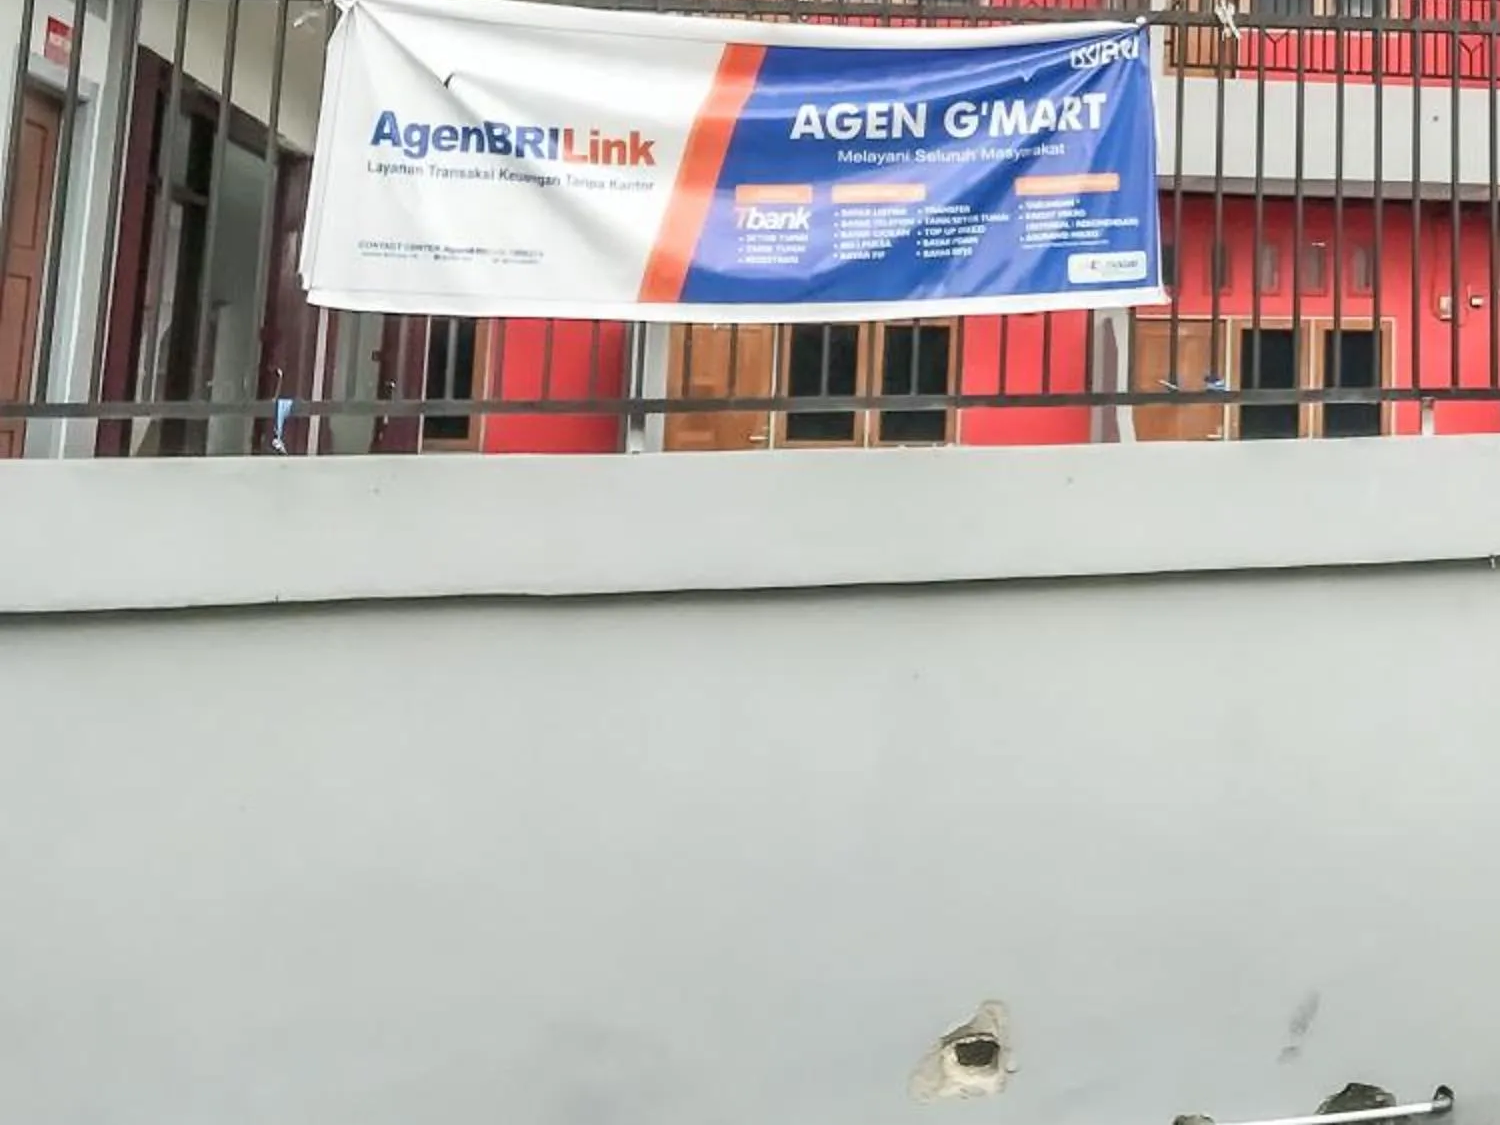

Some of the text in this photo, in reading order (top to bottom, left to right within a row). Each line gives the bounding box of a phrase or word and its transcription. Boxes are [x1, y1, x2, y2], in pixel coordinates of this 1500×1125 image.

[790, 92, 1107, 140] AGEN G'MART
[370, 110, 656, 167] AgenBRILink
[837, 149, 912, 166] Melayani
[914, 147, 977, 164] Seluruh
[367, 160, 424, 176] Layanan
[428, 164, 495, 181] Transaksi
[609, 179, 655, 192] Kantor
